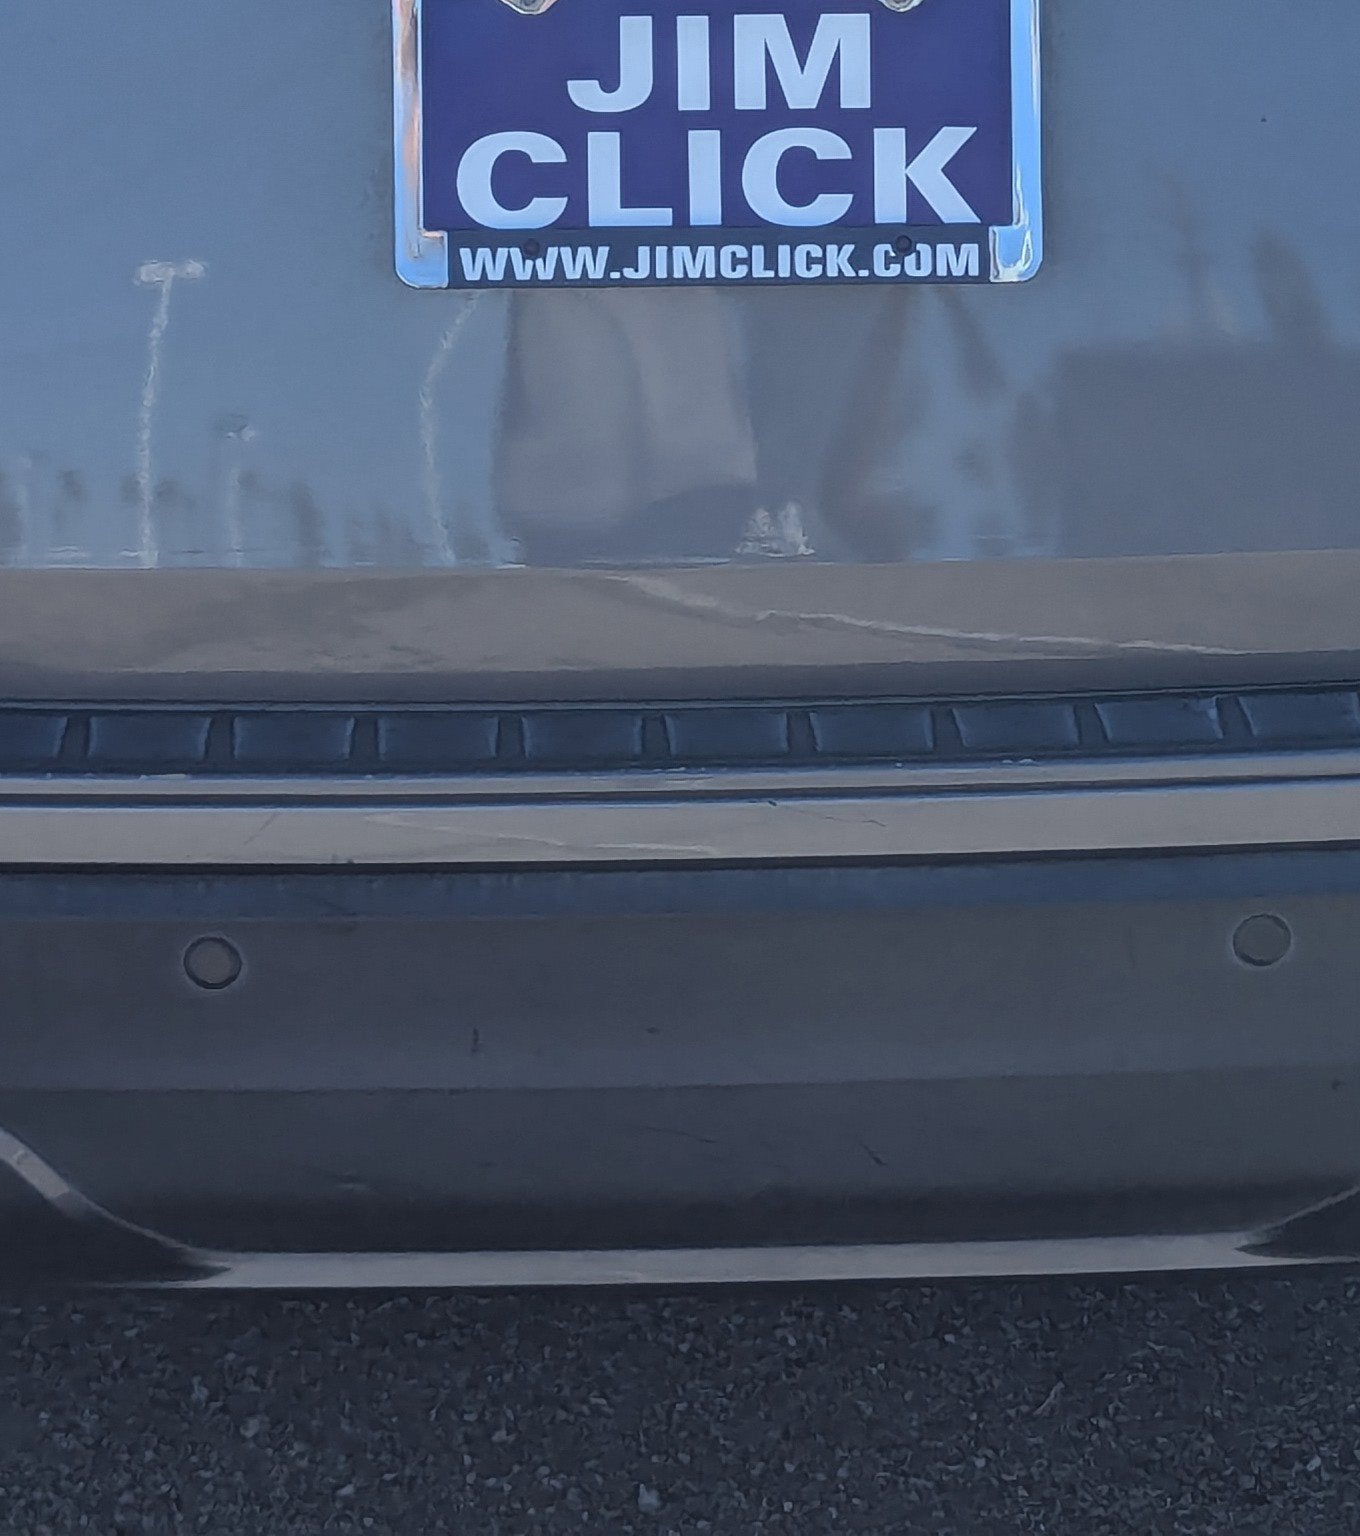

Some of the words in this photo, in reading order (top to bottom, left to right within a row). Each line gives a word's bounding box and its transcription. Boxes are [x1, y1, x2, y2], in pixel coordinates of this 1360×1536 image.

[566, 12, 871, 113] JIM
[455, 125, 982, 230] CLICK
[458, 242, 981, 282] WWW.JIMCLICK.COM
